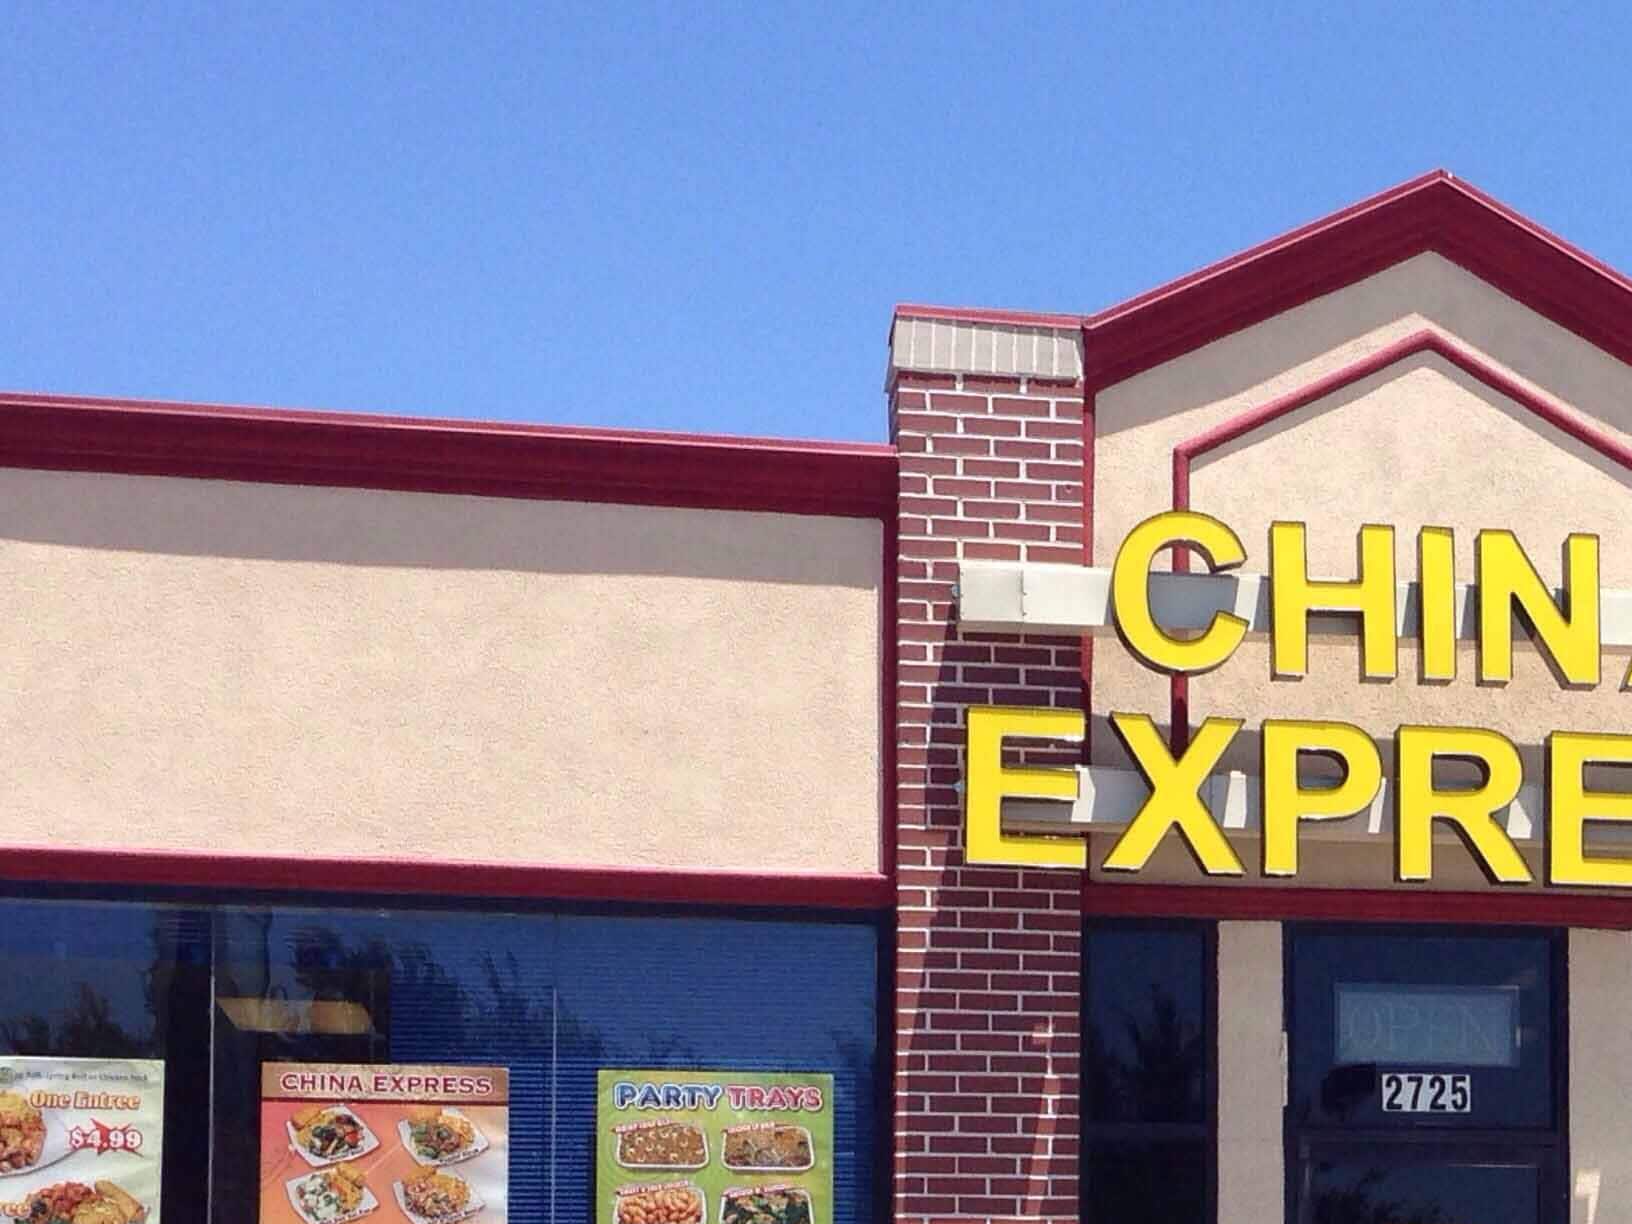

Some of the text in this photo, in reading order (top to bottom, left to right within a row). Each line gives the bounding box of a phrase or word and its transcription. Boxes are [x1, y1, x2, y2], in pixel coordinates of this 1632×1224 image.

[280, 1073, 493, 1095] CHINA EXPRESS
[1384, 1075, 1468, 1110] 2725
[30, 1089, 141, 1110] One Entree
[614, 1082, 823, 1112] PARTY TRAYS
[69, 1127, 143, 1149] $4.99
